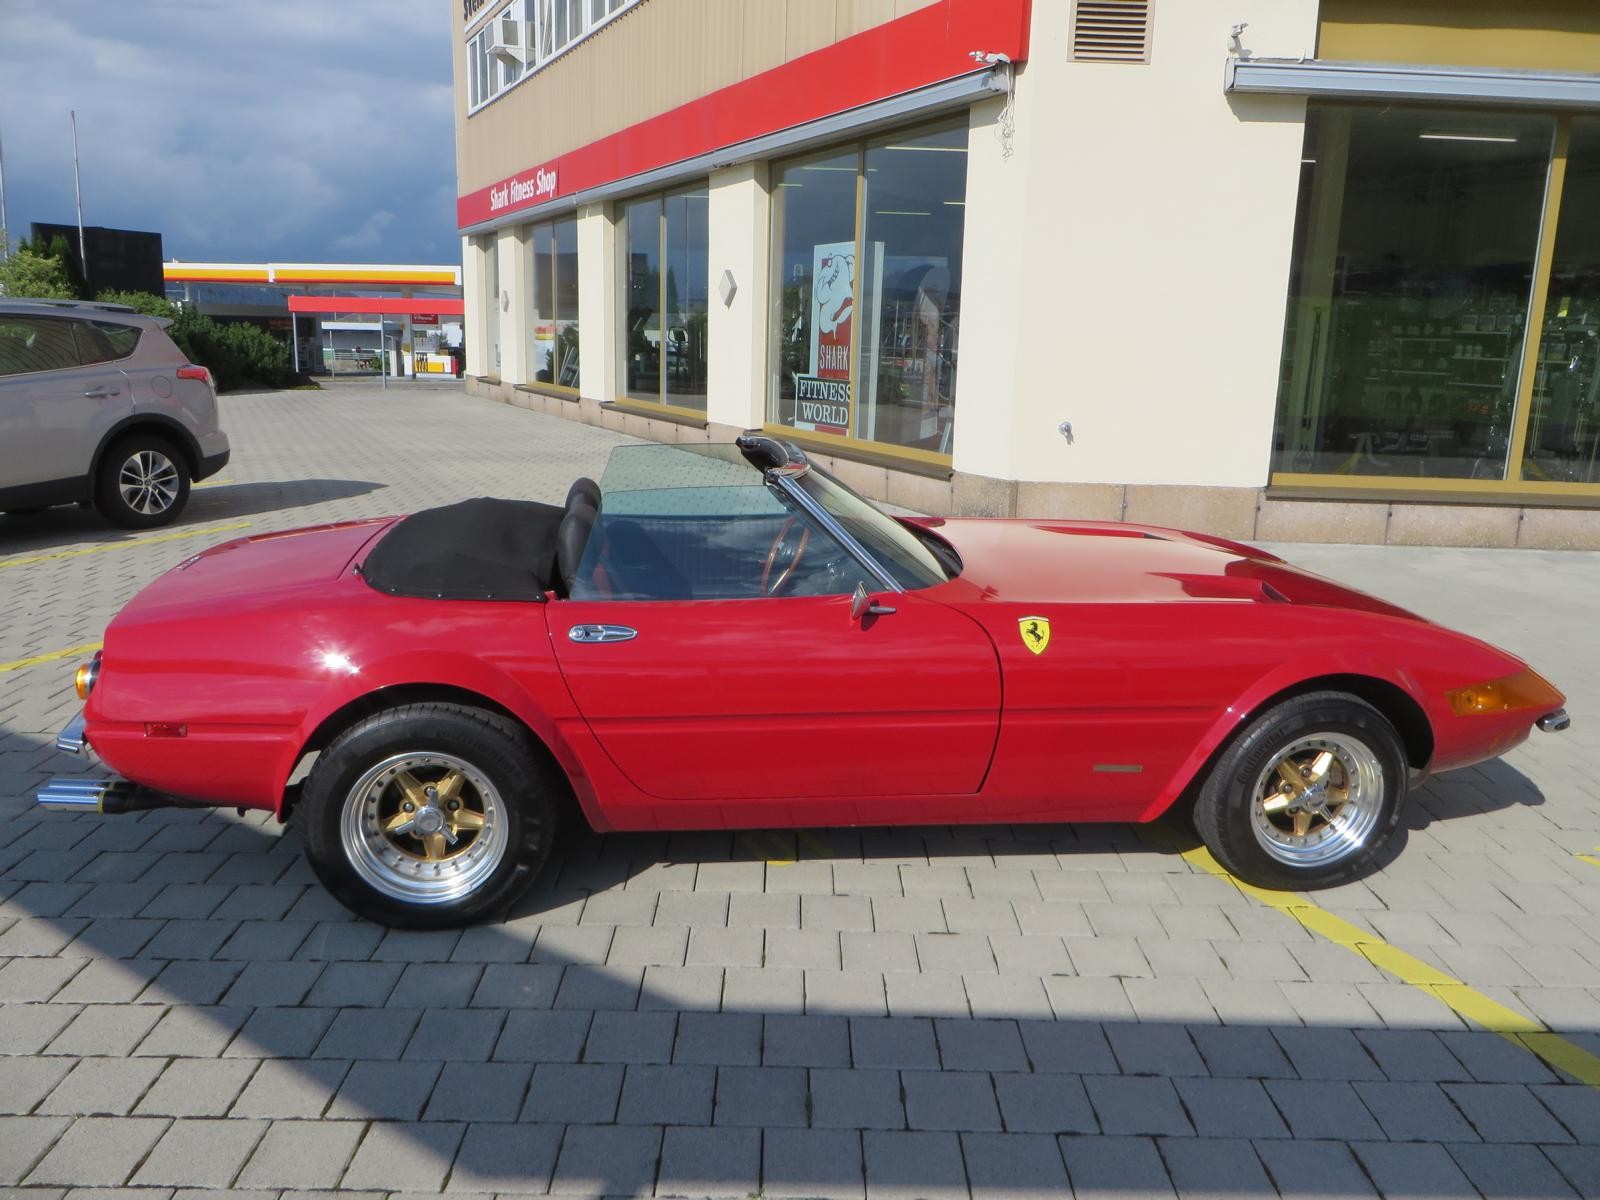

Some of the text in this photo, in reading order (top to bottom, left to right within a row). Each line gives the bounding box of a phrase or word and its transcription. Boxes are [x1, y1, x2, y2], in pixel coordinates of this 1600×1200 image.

[491, 167, 556, 211] Shark Fitness Shop
[820, 345, 849, 371] SHARK
[799, 380, 851, 403] FITNESS
[802, 402, 849, 425] WORLD
